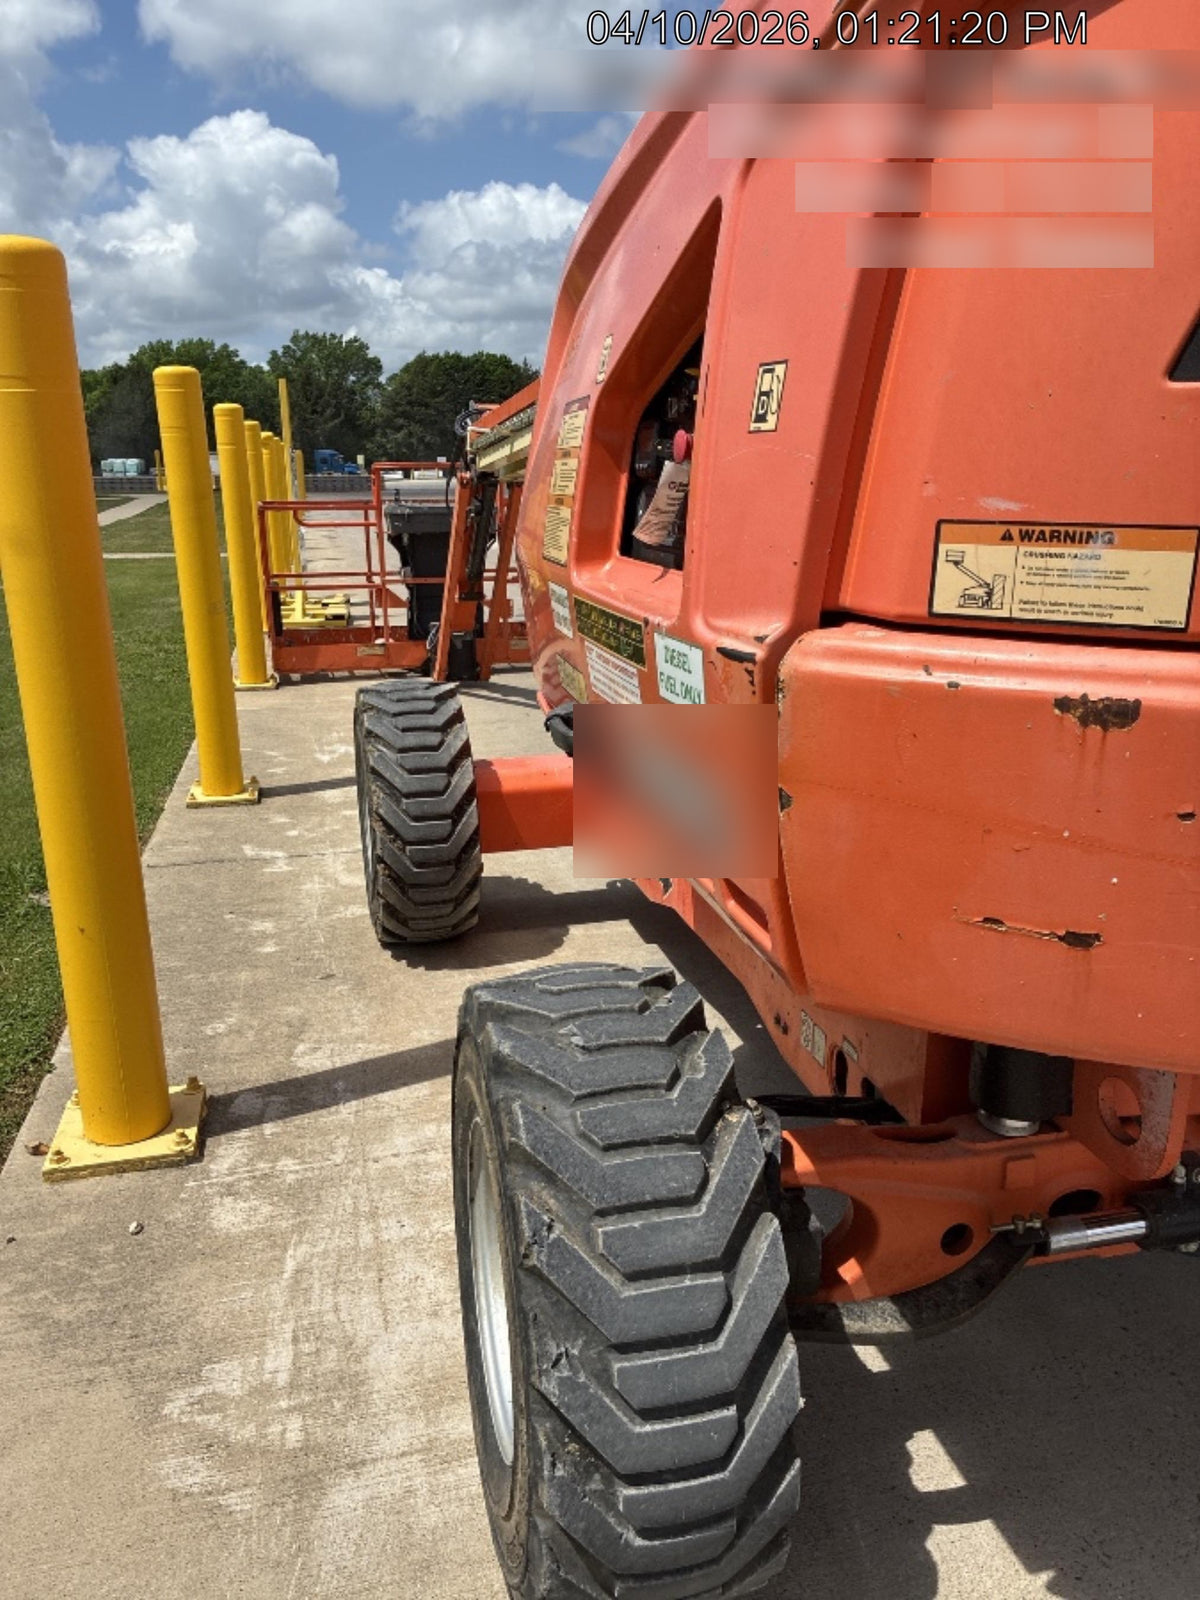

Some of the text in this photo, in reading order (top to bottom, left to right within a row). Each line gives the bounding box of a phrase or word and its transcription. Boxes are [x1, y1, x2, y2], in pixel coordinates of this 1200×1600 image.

[1018, 528, 1115, 546] WARNING
[1023, 551, 1066, 559] CRUSHING
[663, 645, 692, 674] DIESEL
[659, 671, 679, 697] FUEL
